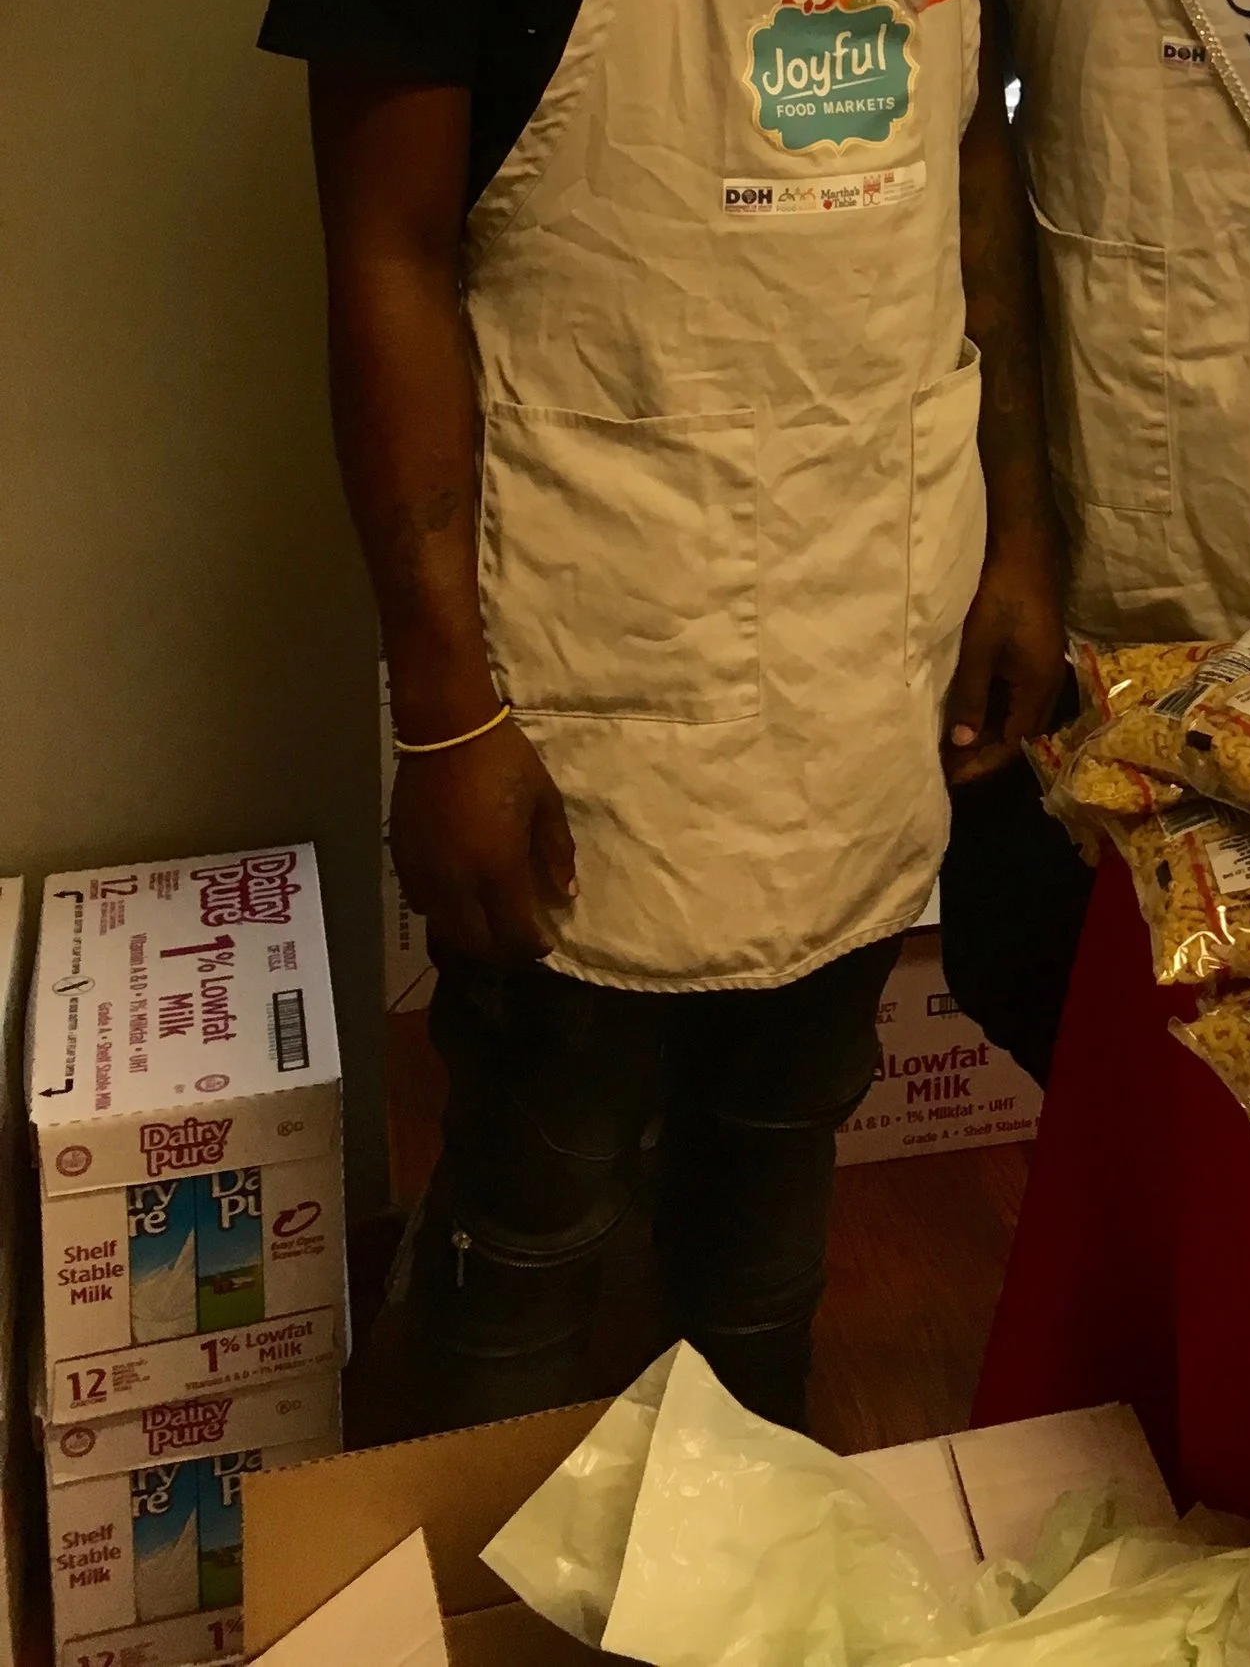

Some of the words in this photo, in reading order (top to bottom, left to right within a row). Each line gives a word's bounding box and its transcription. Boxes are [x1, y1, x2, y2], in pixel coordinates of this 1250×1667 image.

[761, 23, 888, 98] Joyful
[1164, 44, 1206, 63] DOH
[776, 102, 817, 119] FOOD
[823, 96, 896, 114] MARKETS
[725, 188, 773, 205] DOH
[820, 185, 861, 200] Martha's
[100, 875, 138, 899] 12
[191, 864, 244, 927] Pure
[245, 851, 301, 925] Dairy
[129, 933, 148, 966] Vitamin
[160, 934, 235, 973] 1%
[201, 975, 237, 1044] Lowfat
[158, 992, 195, 1039] Milk
[129, 1054, 148, 1074] UHT
[888, 1042, 990, 1079] Lowfat
[906, 1074, 971, 1104] Milk
[853, 1118, 863, 1132] A
[866, 1117, 877, 1130] &
[880, 1115, 890, 1128] D
[928, 1103, 974, 1121] Milkfat
[989, 1096, 1016, 1113] UHT
[140, 1117, 233, 1153] Dairy
[903, 1132, 938, 1146] Grade
[963, 1123, 993, 1138] Shelf
[996, 1119, 1033, 1133] Stable
[147, 1142, 225, 1176] Pure
[64, 1240, 118, 1264] Shelf
[57, 1263, 125, 1286] Stable
[70, 1284, 113, 1305] Milk
[200, 1335, 240, 1373] 1%
[245, 1321, 313, 1349] Lowfat
[259, 1341, 302, 1363] Milk
[66, 1368, 107, 1401] 12
[142, 1398, 233, 1434] Dairy
[149, 1420, 225, 1456] Pure
[62, 1523, 115, 1550] Shelf
[56, 1545, 122, 1571] Stable
[69, 1567, 111, 1589] Milk
